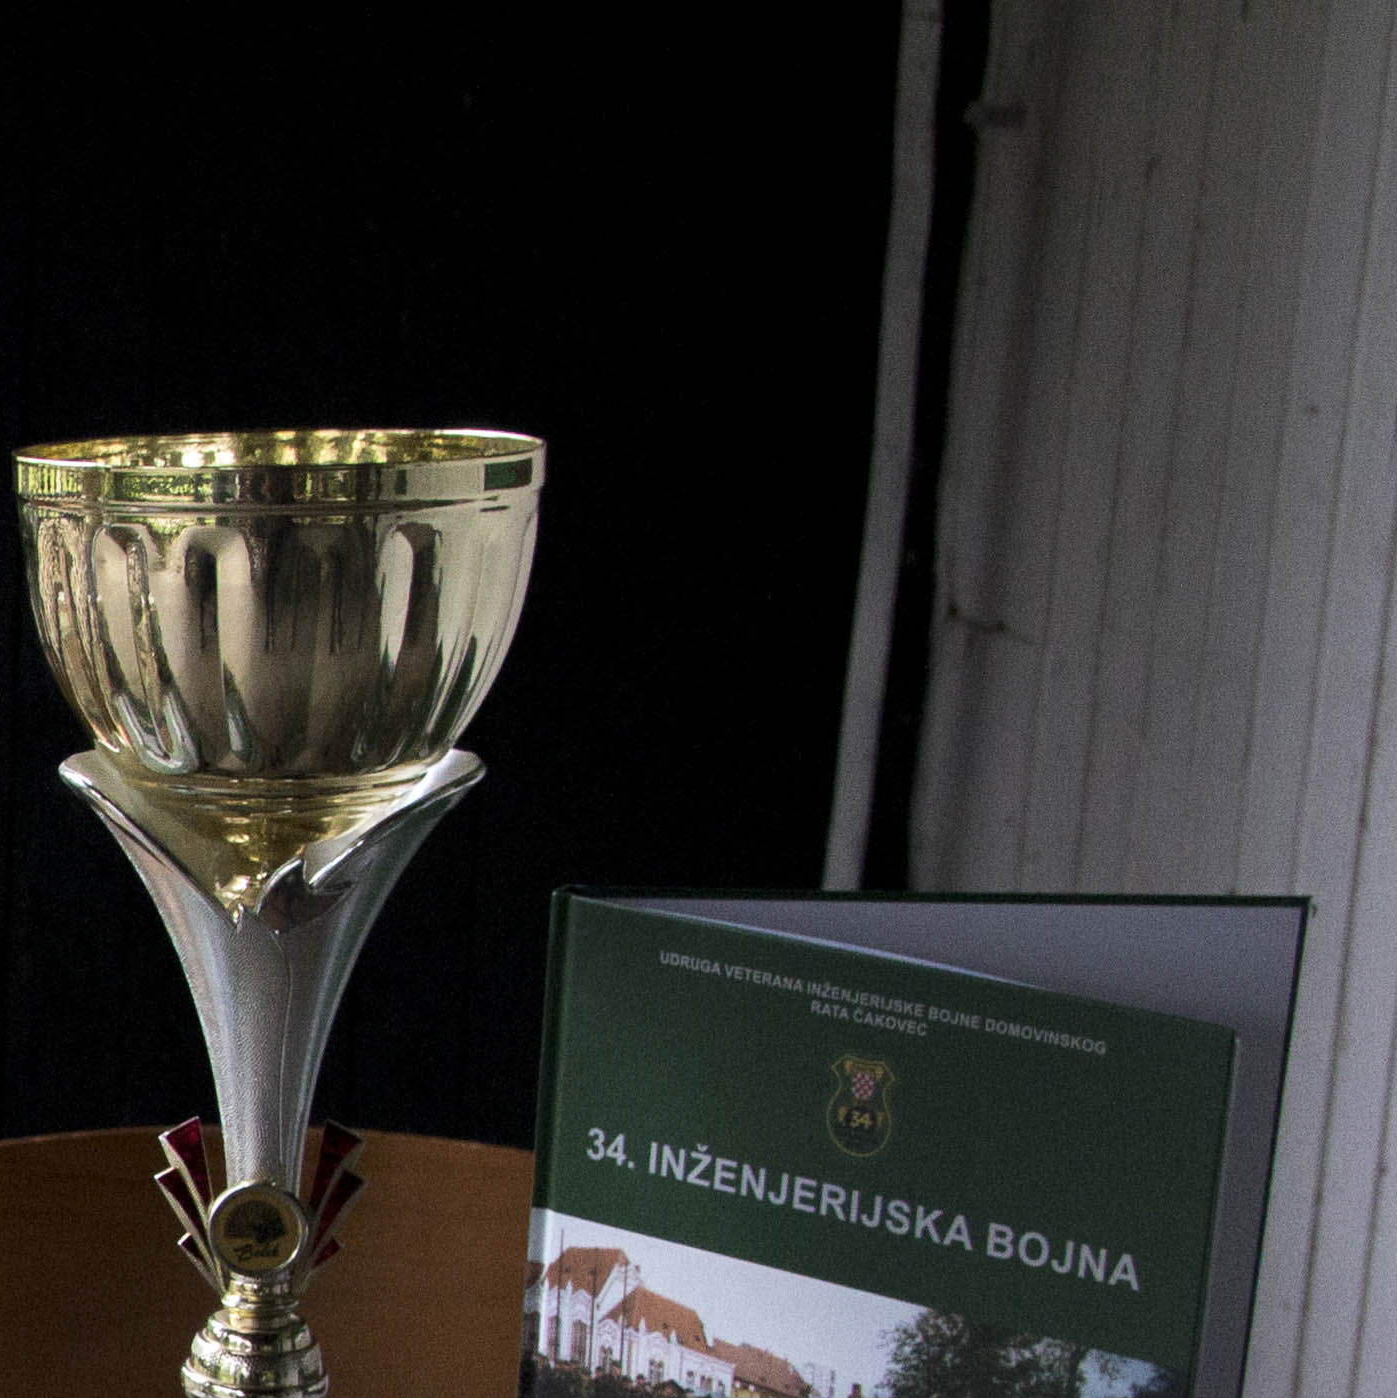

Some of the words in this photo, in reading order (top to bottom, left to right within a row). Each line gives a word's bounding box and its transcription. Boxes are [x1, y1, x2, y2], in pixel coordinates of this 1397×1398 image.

[660, 951, 721, 976] UDRUGA
[724, 963, 803, 992] VETERANA
[807, 982, 925, 1018] INŽENJERIJSKE
[928, 1006, 981, 1030] BOJNE
[985, 1018, 1106, 1056] DOMOVINSKOG
[810, 1000, 848, 1021] RATA
[853, 1006, 927, 1037] ČAKOVEC
[586, 1127, 635, 1169] 34.
[647, 1141, 973, 1251] INŽENJERIJSKA
[986, 1222, 1139, 1292] BOJNA
